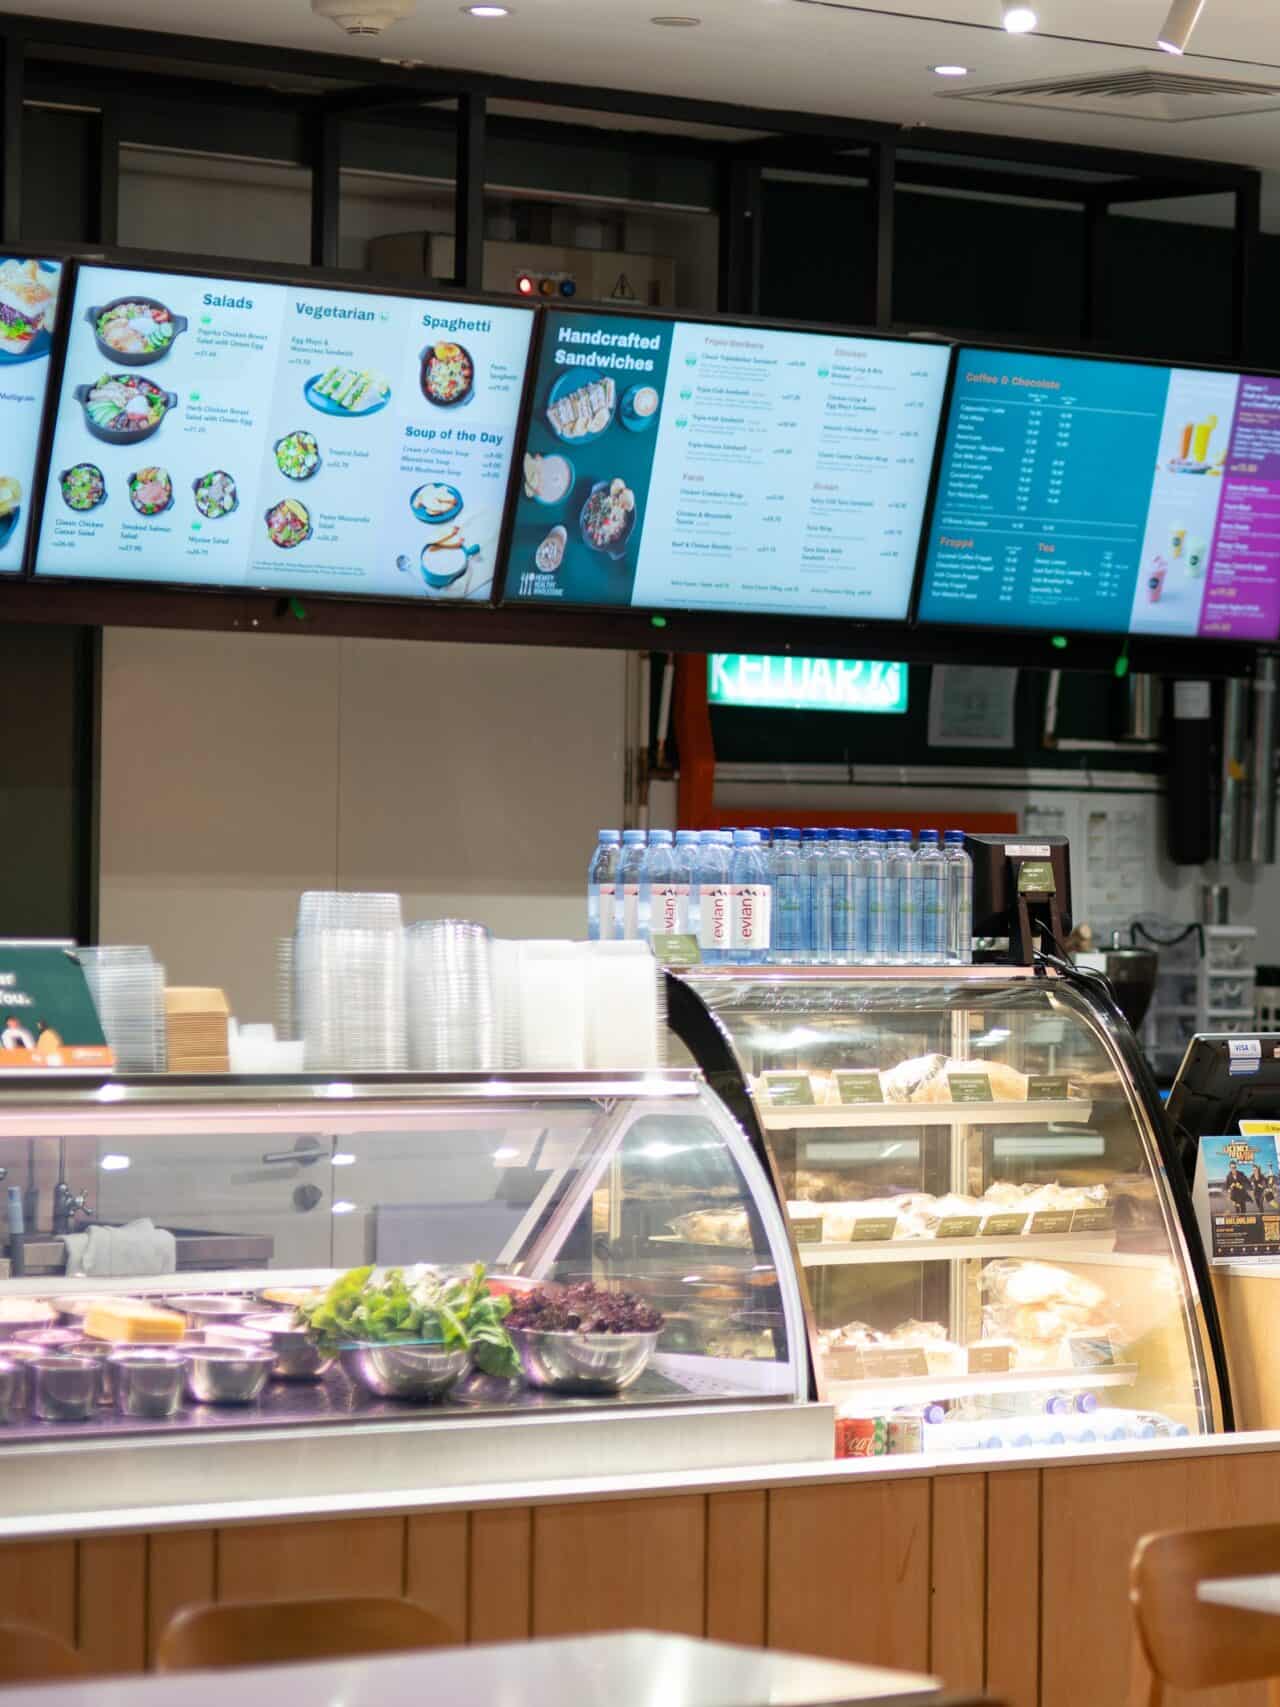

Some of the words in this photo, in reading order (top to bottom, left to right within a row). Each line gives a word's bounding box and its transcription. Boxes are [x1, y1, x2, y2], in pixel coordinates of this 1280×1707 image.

[203, 293, 253, 309] Salads
[295, 302, 375, 321] Vegetarian
[423, 314, 492, 333] Spaghetti
[558, 327, 661, 350] Handcrafted
[554, 349, 654, 371] Sandwiches
[966, 372, 998, 385] Coffee
[1001, 375, 1009, 385] &
[1011, 376, 1060, 390] Chocolate
[405, 426, 436, 440] Soup
[440, 429, 452, 439] of
[457, 431, 476, 442] the
[480, 432, 503, 446] Day
[1038, 542, 1055, 552] Tea
[713, 898, 724, 938] evian
[741, 898, 753, 938] evian
